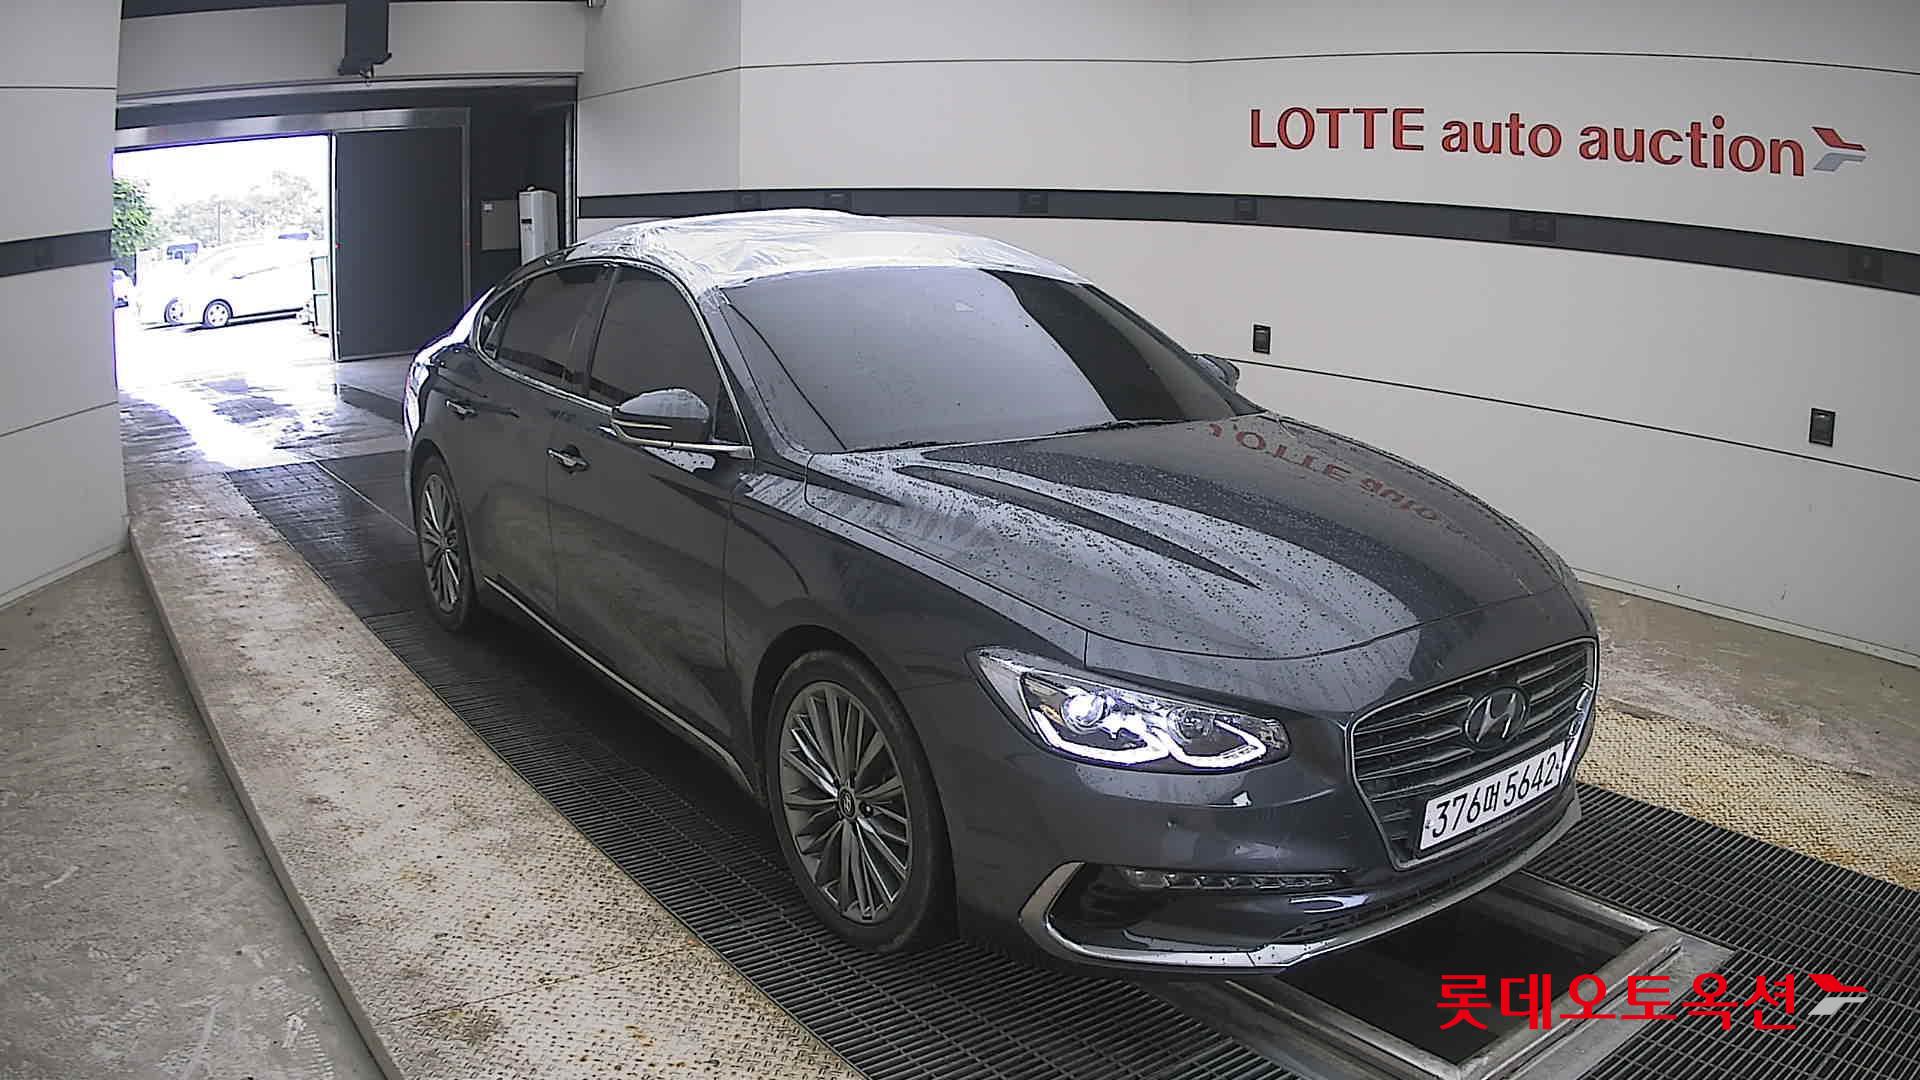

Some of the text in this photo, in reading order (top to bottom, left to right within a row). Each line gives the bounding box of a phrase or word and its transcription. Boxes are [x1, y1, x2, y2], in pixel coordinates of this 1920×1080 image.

[1250, 107, 1806, 177] LOTTE auto auction
[1504, 752, 1557, 807] 5642
